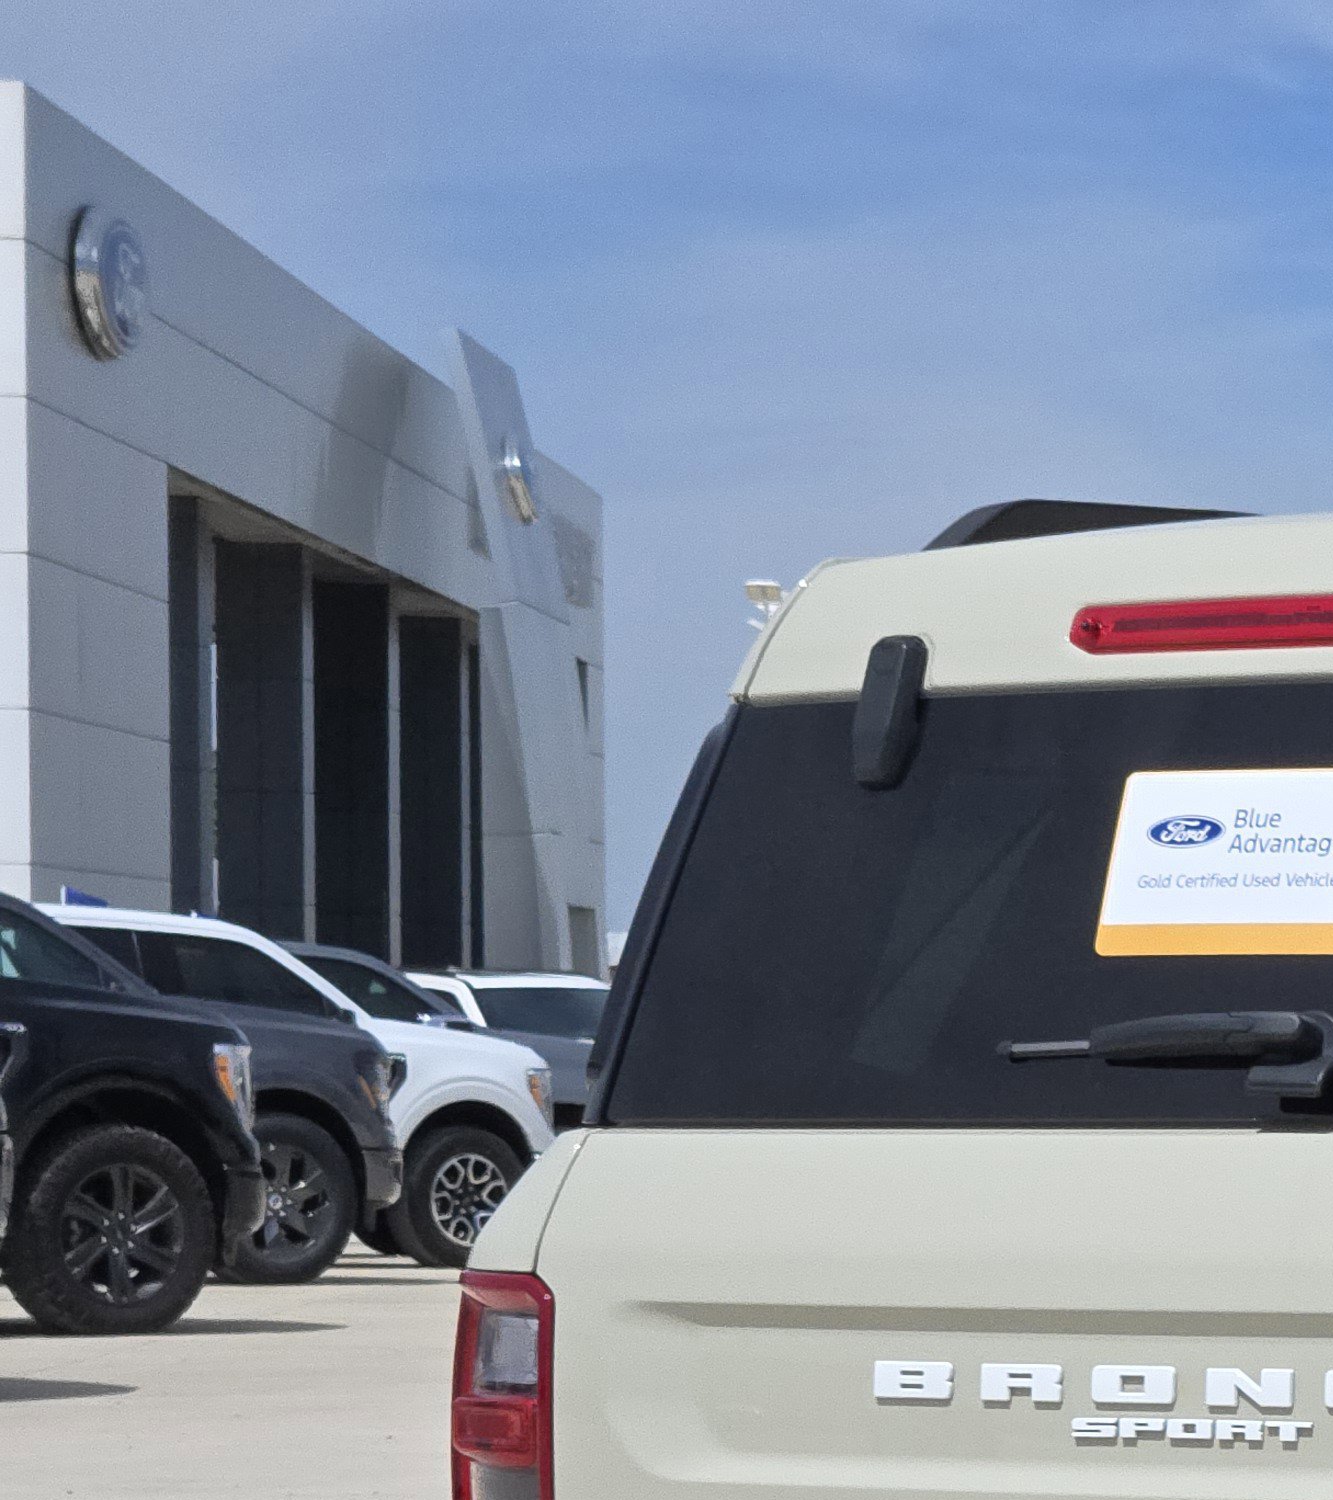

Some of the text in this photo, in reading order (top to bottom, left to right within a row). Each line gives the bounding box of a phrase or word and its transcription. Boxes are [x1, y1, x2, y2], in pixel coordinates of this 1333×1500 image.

[1234, 808, 1282, 829] Blue
[1159, 819, 1212, 843] Ford
[1137, 874, 1172, 889] Gold
[1176, 873, 1239, 888] Certified
[1242, 873, 1281, 888] Used
[1071, 1417, 1315, 1444] SPORT
